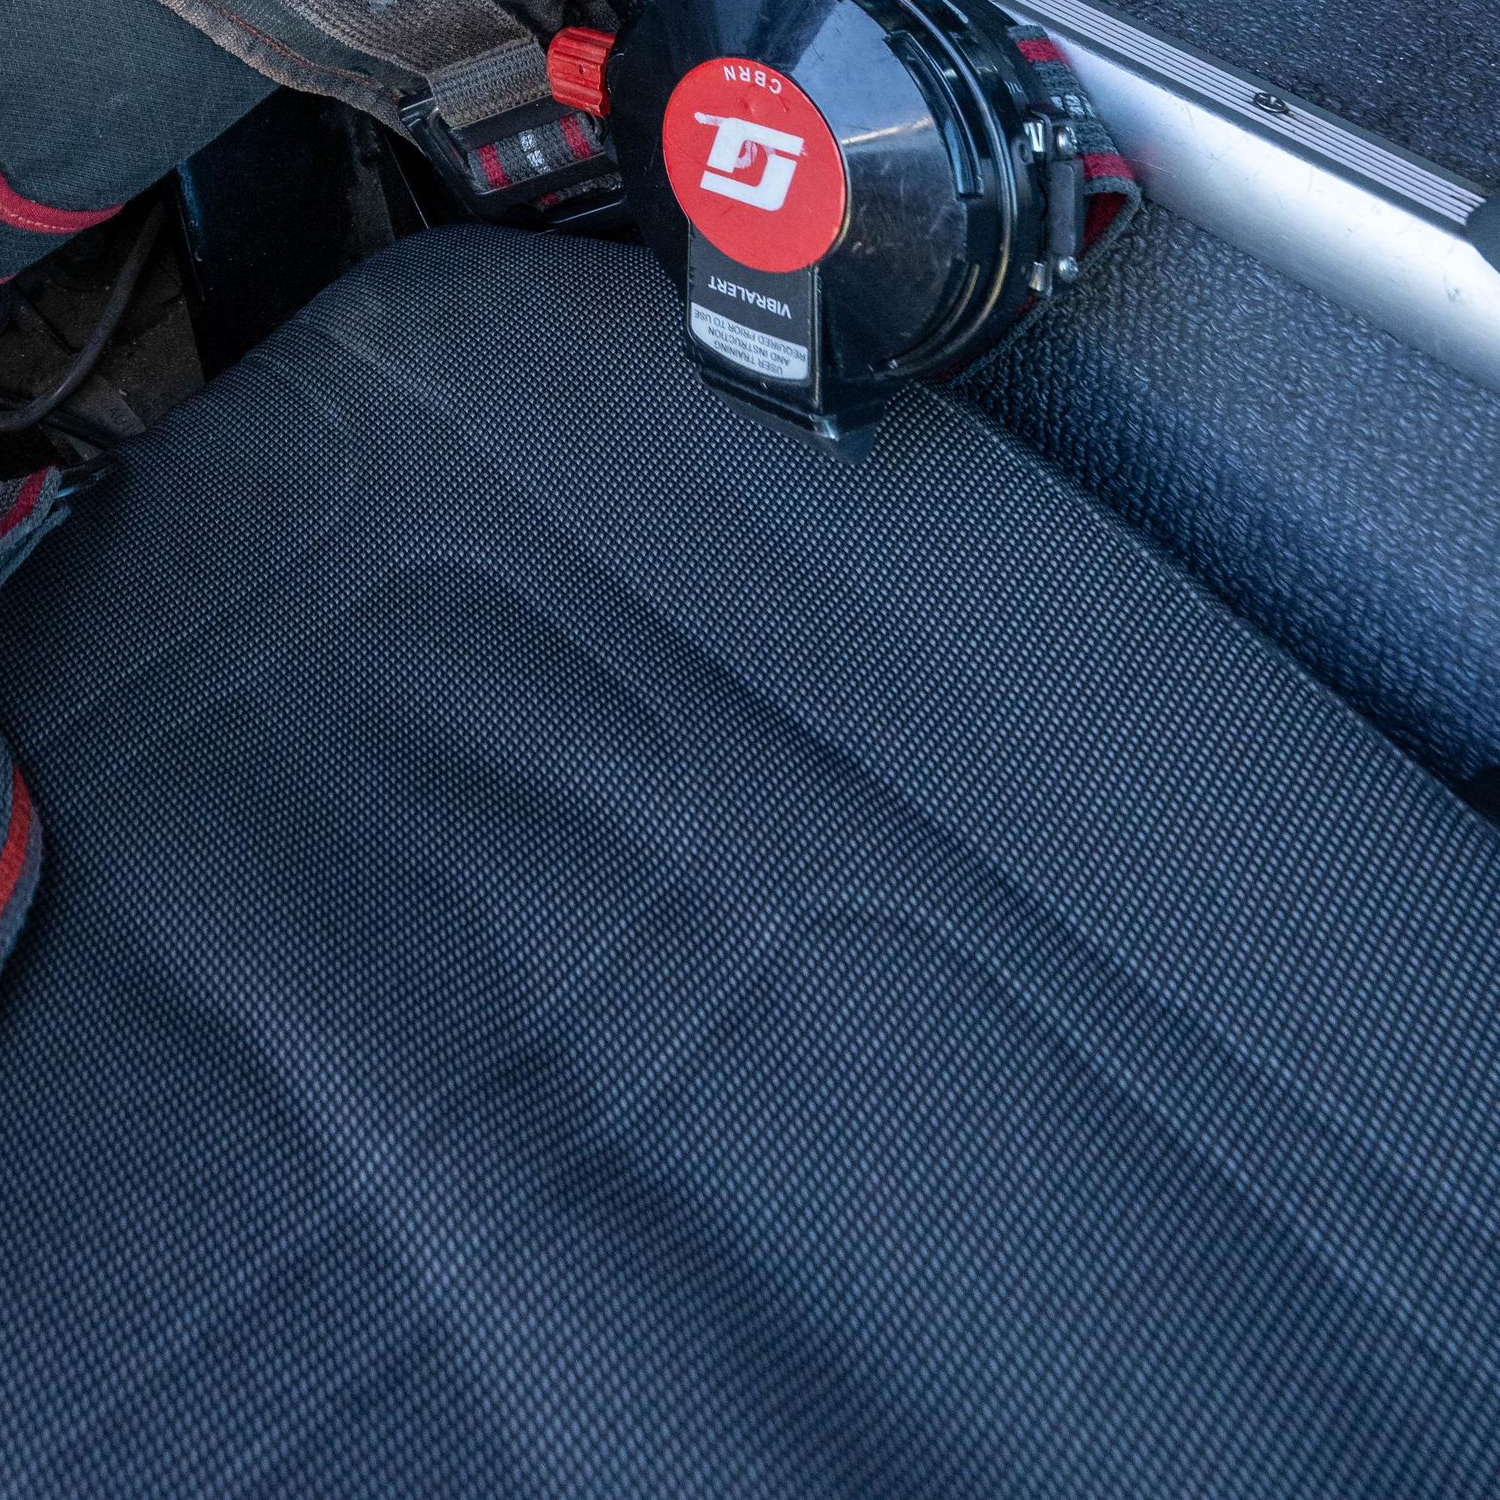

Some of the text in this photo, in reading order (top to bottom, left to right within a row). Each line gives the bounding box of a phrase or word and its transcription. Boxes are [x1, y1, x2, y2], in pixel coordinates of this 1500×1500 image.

[724, 65, 782, 95] CBRN
[708, 275, 792, 320] VIBRALERT
[694, 309, 806, 360] REQUIRED PRIOR TO USE
[708, 327, 790, 366] AND INSTRUCTION
[714, 341, 783, 375] USER TRAINING
